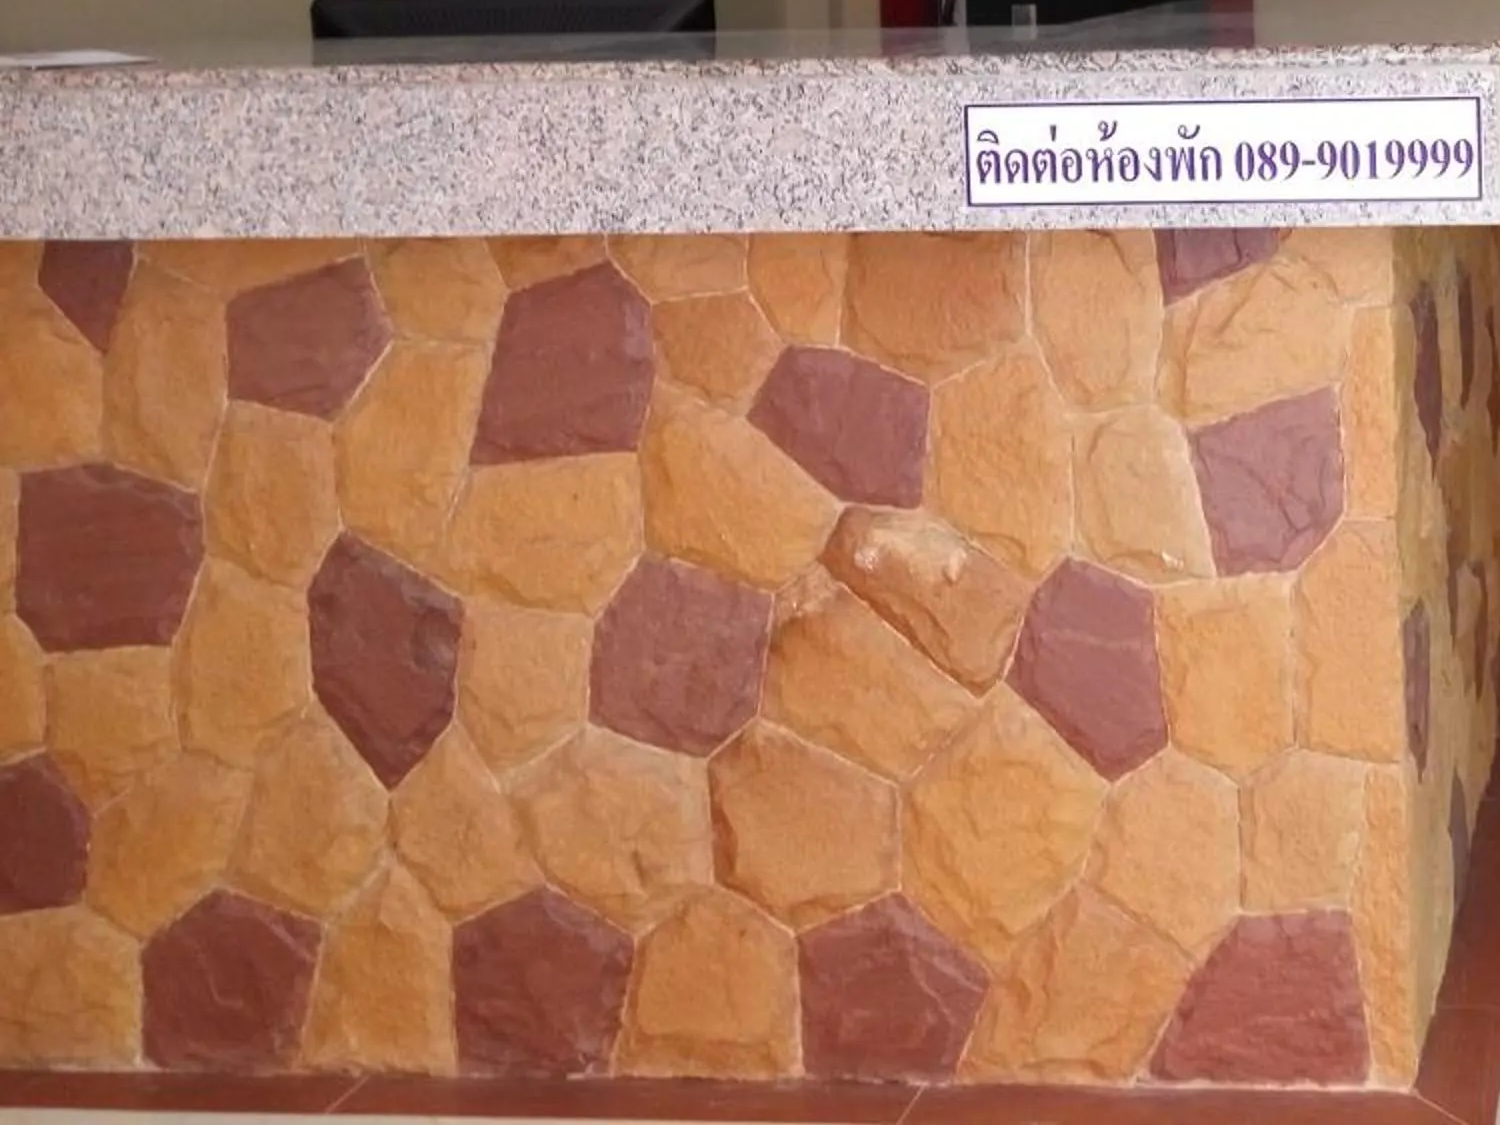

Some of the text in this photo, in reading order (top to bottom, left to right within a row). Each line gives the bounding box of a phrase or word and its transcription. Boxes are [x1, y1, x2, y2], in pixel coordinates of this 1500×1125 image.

[976, 120, 1475, 184] ติดต่อห้องพัก 089-9019999
